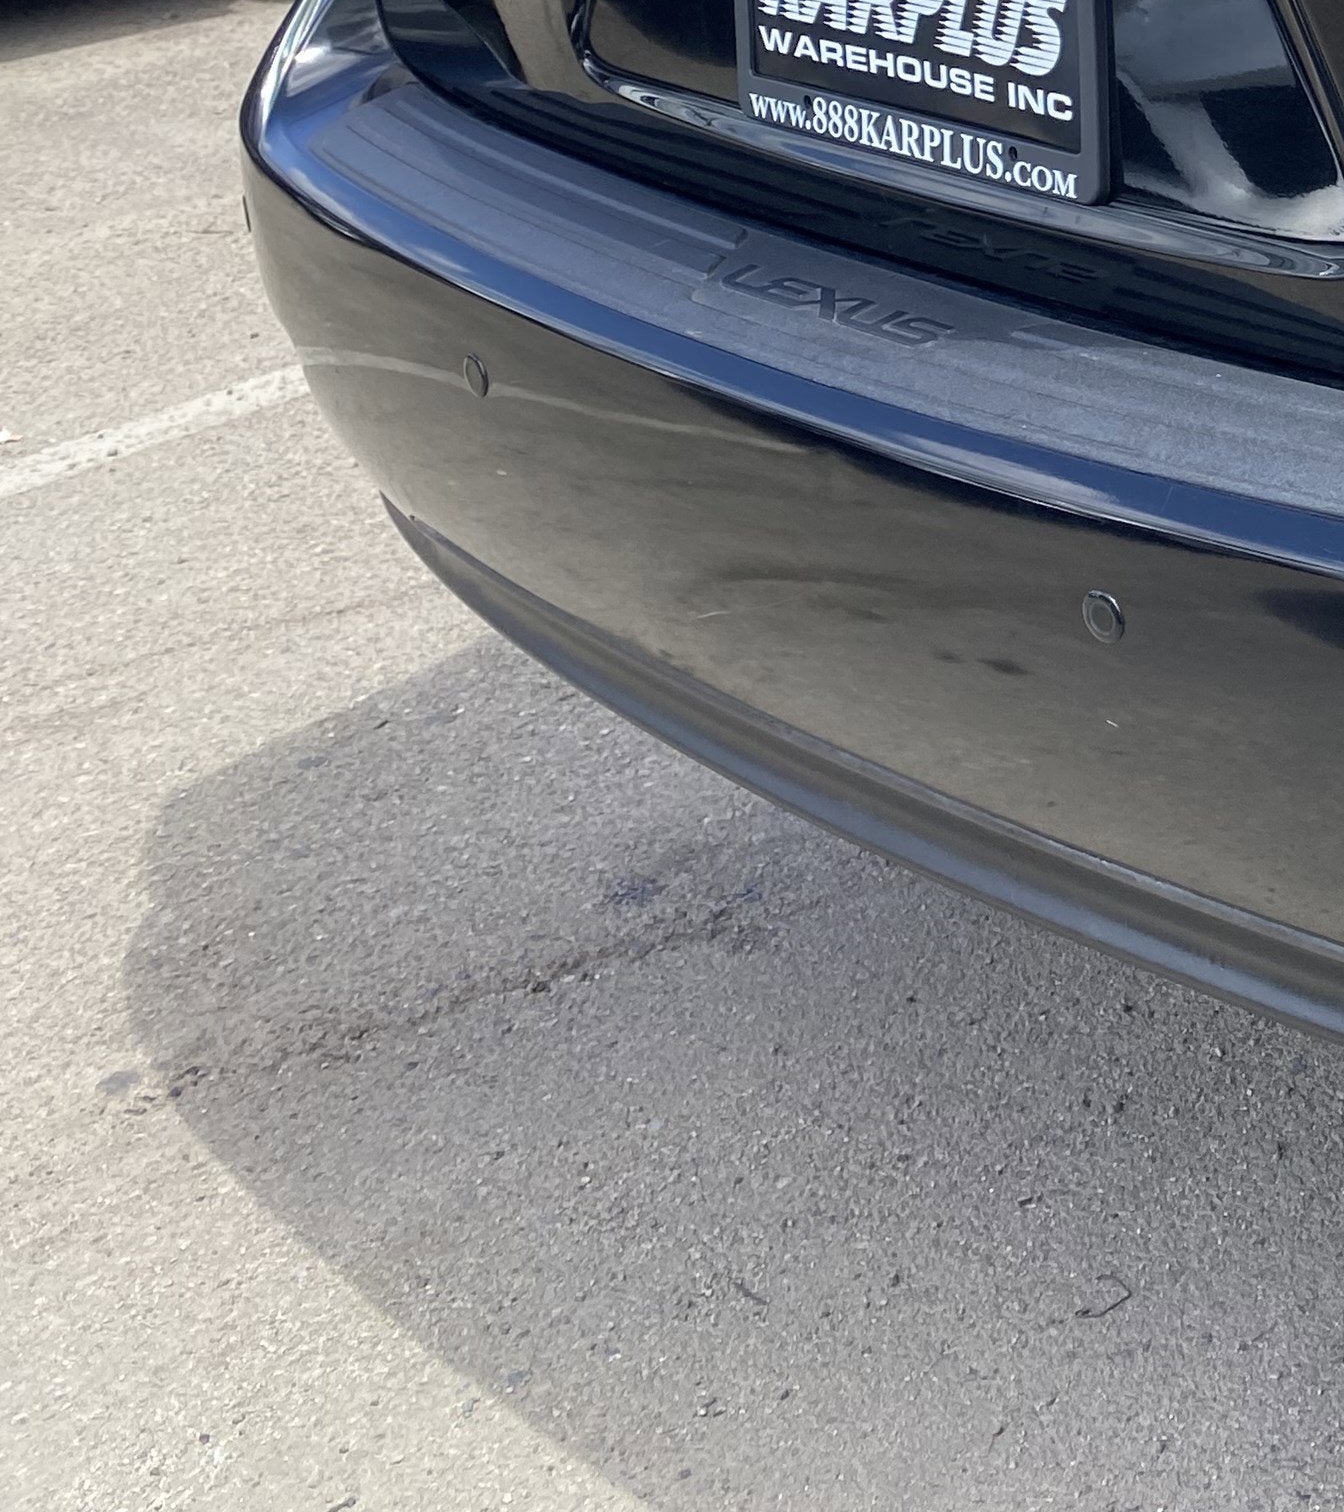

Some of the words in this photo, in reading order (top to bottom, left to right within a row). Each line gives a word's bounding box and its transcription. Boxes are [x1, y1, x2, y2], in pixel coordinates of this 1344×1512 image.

[758, 25, 995, 102] WAREHOUSE
[1008, 82, 1074, 121] INC
[720, 264, 954, 348] LEXUS
